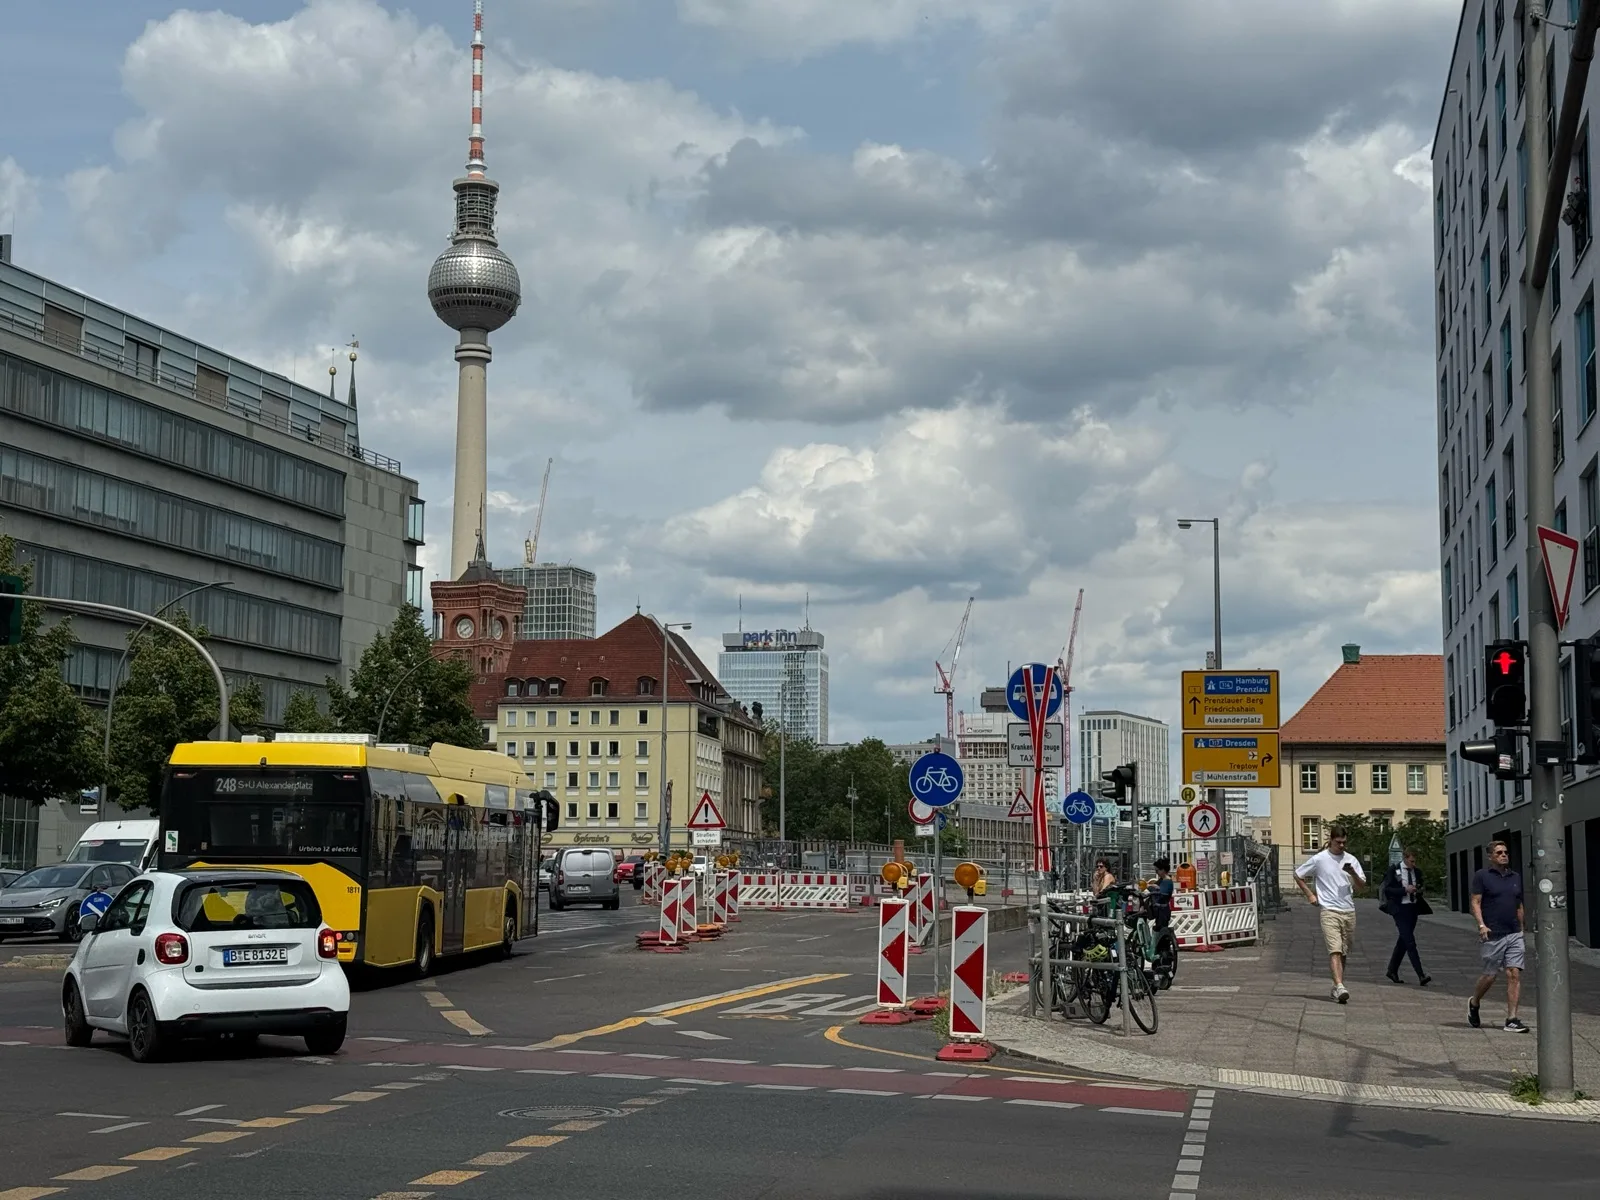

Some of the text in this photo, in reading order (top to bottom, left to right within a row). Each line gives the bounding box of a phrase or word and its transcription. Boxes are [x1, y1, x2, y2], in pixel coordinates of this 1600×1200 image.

[743, 629, 797, 645] park inn
[1235, 677, 1269, 685] Hamburg
[1207, 716, 1261, 724] Alexanderplatz
[1229, 762, 1258, 770] Treptow
[216, 778, 314, 792] 248 S+U Alexanderplatz
[347, 886, 361, 894] 1811
[230, 950, 238, 962] B
